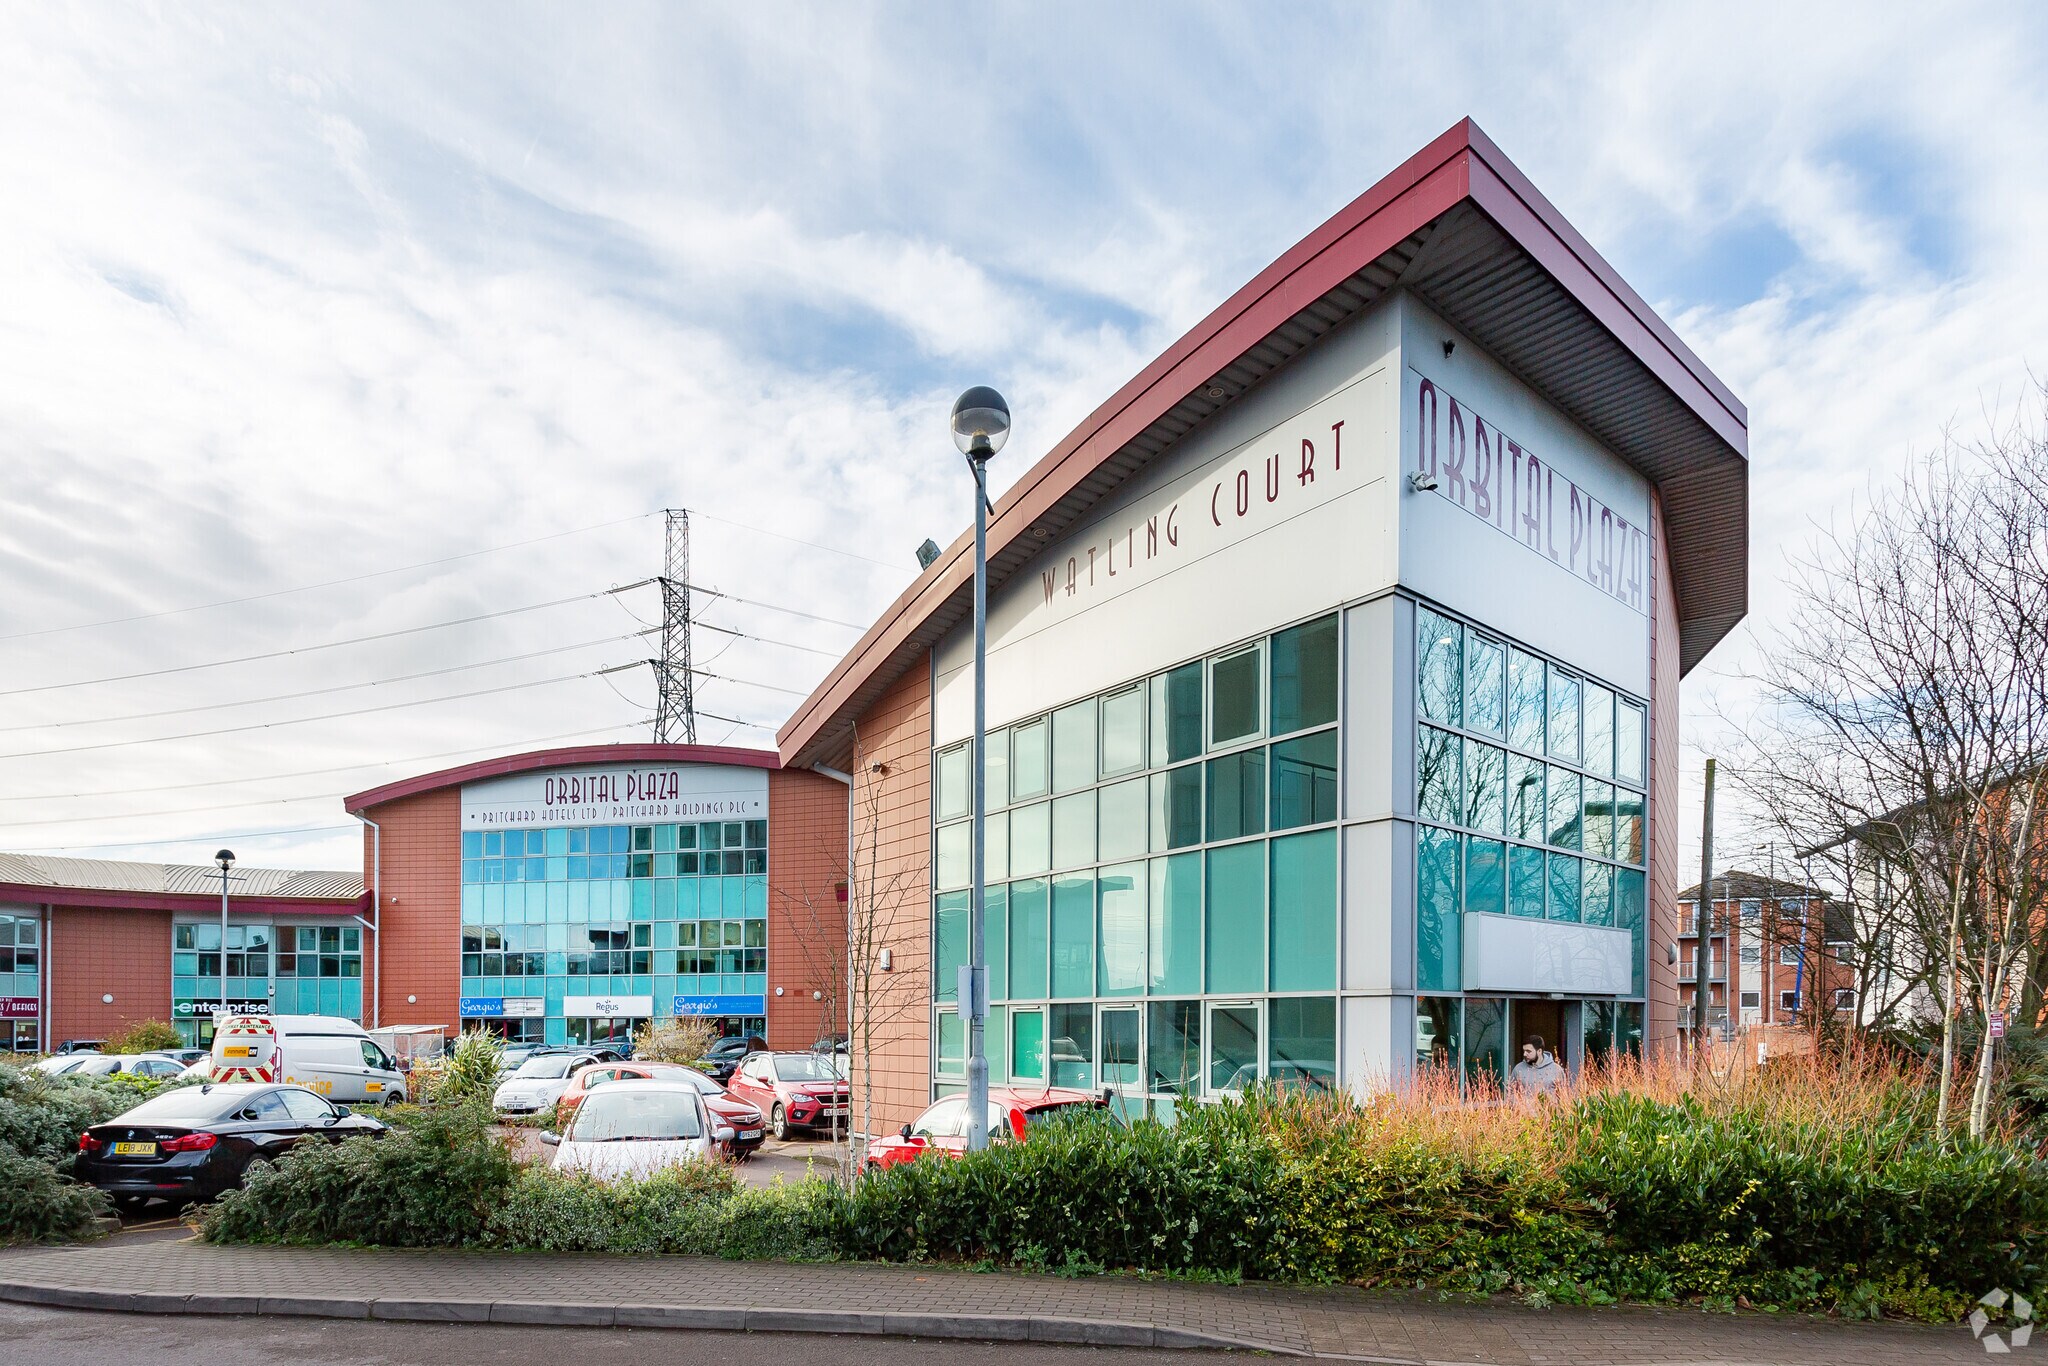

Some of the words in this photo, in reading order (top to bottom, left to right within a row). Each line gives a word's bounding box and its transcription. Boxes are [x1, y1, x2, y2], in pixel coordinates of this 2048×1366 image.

[1419, 378, 1559, 563] ORBITAL
[1570, 483, 1643, 611] PLAZA
[1042, 504, 1178, 608] WATLING
[1211, 420, 1345, 527] COURT
[545, 775, 620, 805] ORBITAL
[627, 771, 679, 801] PLAZA
[482, 809, 536, 823] PRITCHARD
[542, 808, 576, 821] HOTELS
[581, 807, 597, 820] LTD
[613, 804, 669, 818] PRITCHARD
[675, 801, 724, 816] HOLDINGS
[729, 801, 746, 813] PLC
[12, 1002, 37, 1012] OFFICES
[461, 998, 501, 1015] Georgio's
[595, 1002, 619, 1014] Regus
[675, 997, 718, 1014] Georgio's
[117, 1143, 136, 1153] LE18
[136, 1143, 153, 1153] JXK
